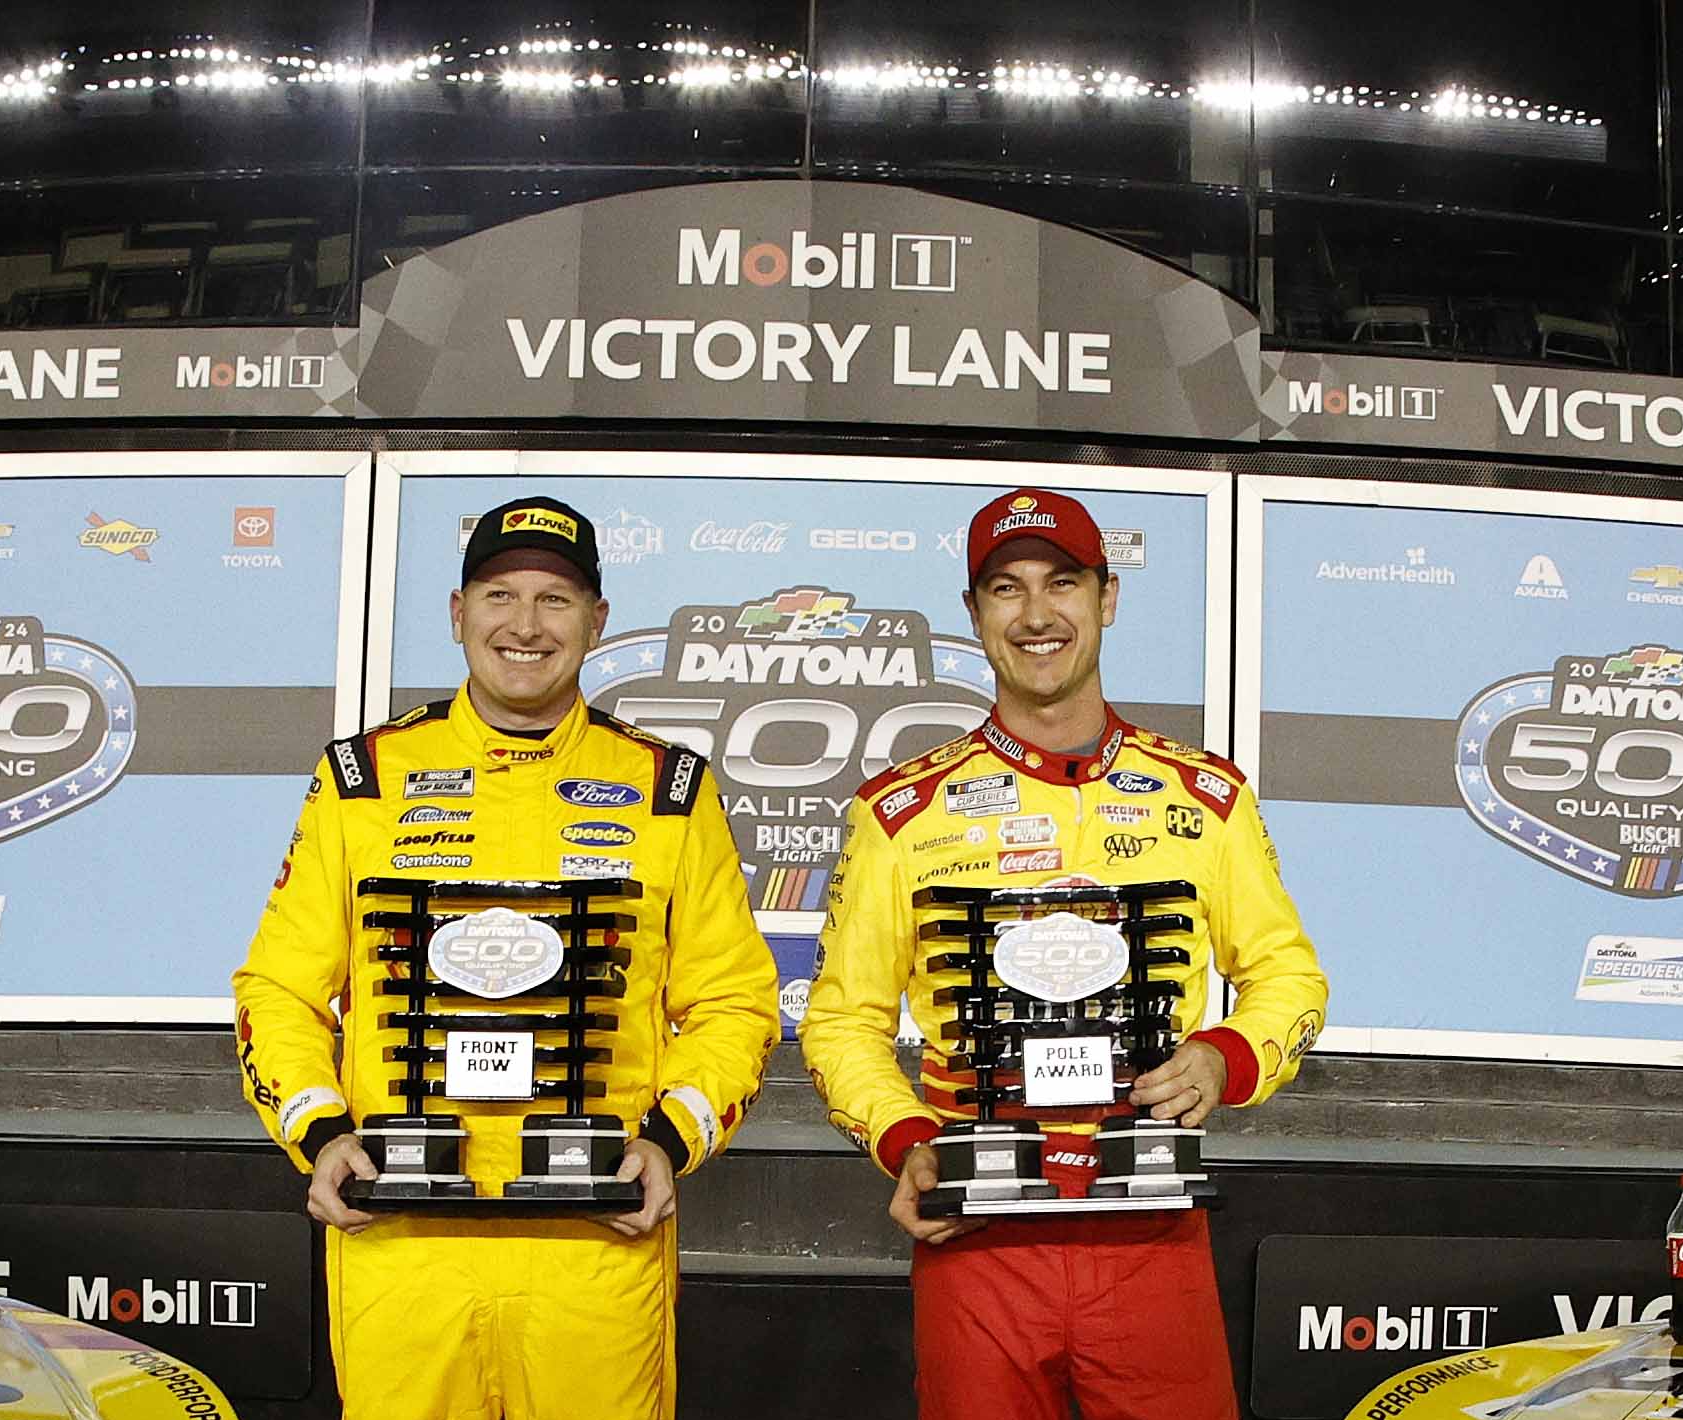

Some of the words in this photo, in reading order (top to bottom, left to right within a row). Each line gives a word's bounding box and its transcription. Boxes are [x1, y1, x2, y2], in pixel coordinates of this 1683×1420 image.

[677, 228, 874, 290] Mobil
[506, 319, 870, 384] VICTORY
[893, 325, 1112, 394] LANE
[176, 355, 281, 391] Mobil
[1288, 382, 1393, 418] Mobil
[992, 510, 1058, 538] PENNZOIL
[85, 527, 154, 548] SUNOCO
[597, 527, 663, 552] USCH
[689, 520, 790, 553] Coca-Cola
[809, 529, 916, 551] GEICO
[221, 554, 283, 569] TOYOTA
[1514, 585, 1568, 600] AXALTA
[5, 622, 29, 638] 24
[691, 616, 725, 634] 20
[877, 619, 909, 638] 24
[677, 643, 918, 688] DAYTONA
[1569, 663, 1596, 678] 20
[669, 753, 694, 804] sparco
[967, 776, 1006, 793] NASCAR
[1115, 773, 1154, 792] Ford
[1196, 770, 1232, 799] OMP
[571, 782, 627, 804] Ford
[880, 787, 919, 816] OMP
[956, 795, 975, 807] CUP
[975, 791, 1008, 804] SERIES
[1167, 807, 1203, 835] PPG
[393, 831, 475, 847] GOODYEAR
[562, 826, 635, 844] speedco
[756, 825, 842, 853] BUSCH
[912, 832, 965, 853] Autotrader
[1619, 823, 1682, 850] BUSCH
[1108, 836, 1136, 859] AAA
[1630, 843, 1669, 855] LIGHT
[392, 852, 472, 869] Benebone
[1000, 849, 1060, 874] Coca-Cola
[917, 860, 991, 884] GOODYEAR
[449, 937, 545, 963] 500
[1014, 943, 1109, 967] 500
[460, 1041, 519, 1055] FRONT
[1046, 1046, 1090, 1060] POLE
[467, 1058, 511, 1072] ROW
[1034, 1063, 1104, 1079] AWARD
[1045, 1151, 1098, 1168] JOEY
[67, 1276, 200, 1326] Mobil
[1298, 1305, 1433, 1352] Mobil
